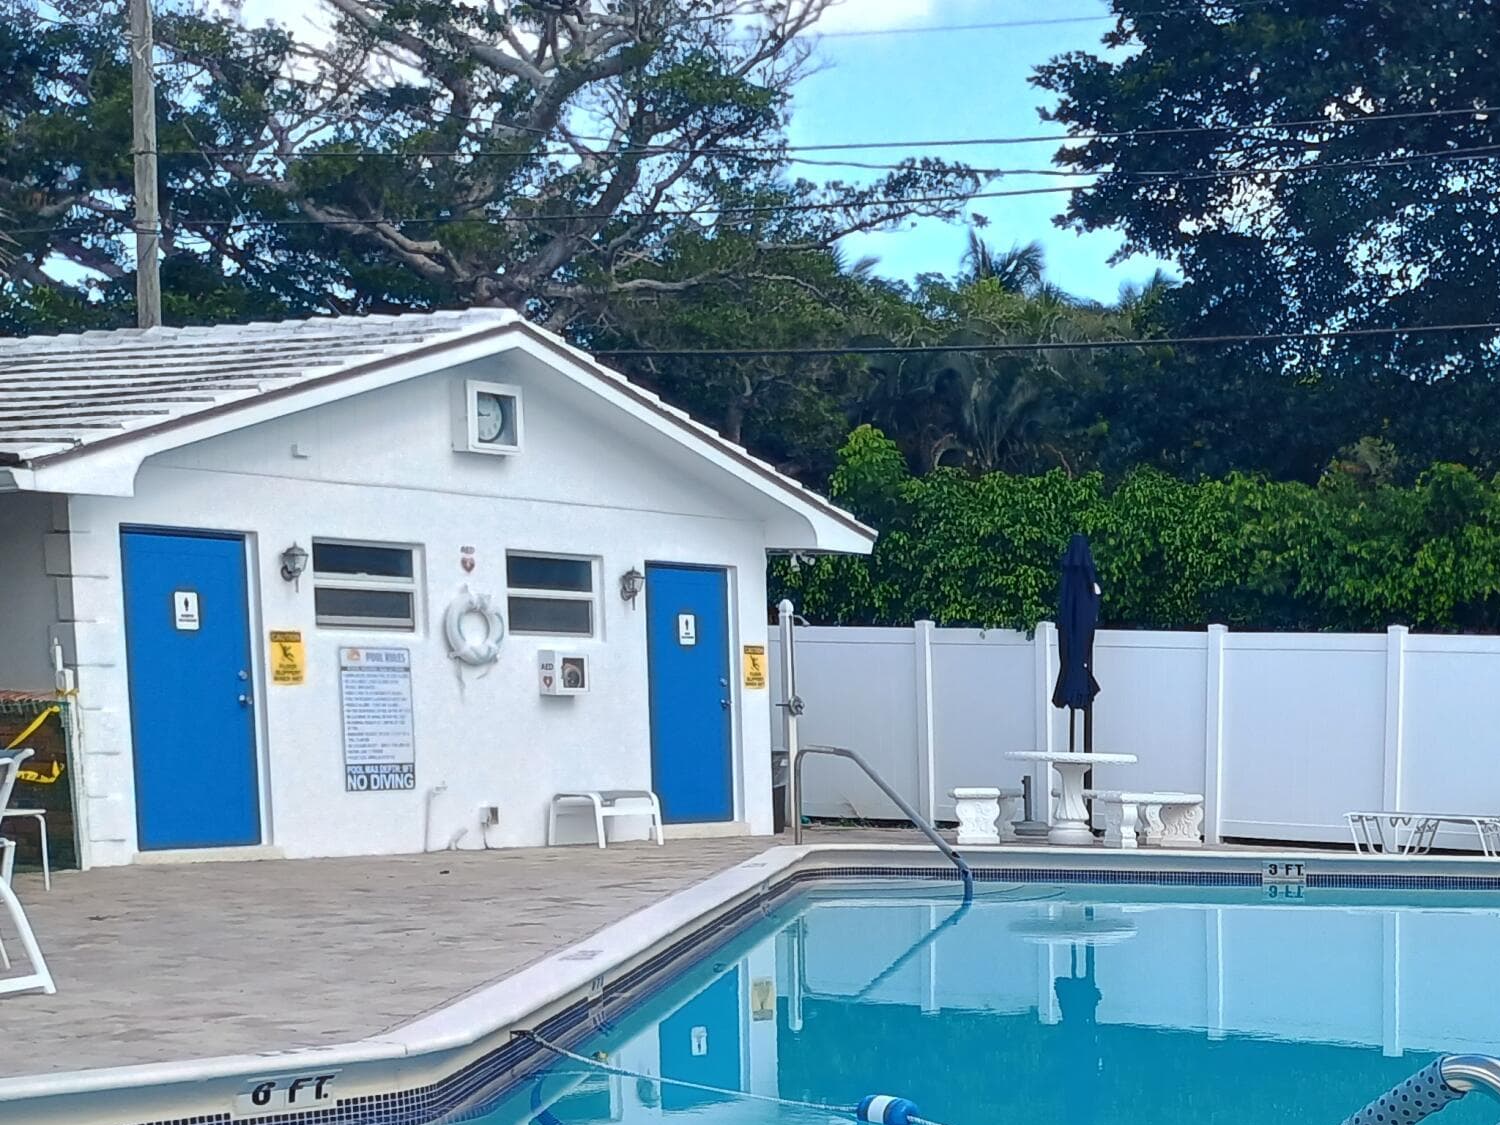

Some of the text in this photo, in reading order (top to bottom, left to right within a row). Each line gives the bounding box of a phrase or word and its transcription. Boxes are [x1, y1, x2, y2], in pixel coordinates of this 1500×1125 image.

[347, 773, 414, 790] NO DIVING
[1268, 863, 1278, 876] 3
[252, 1074, 336, 1106] 6 FT.
